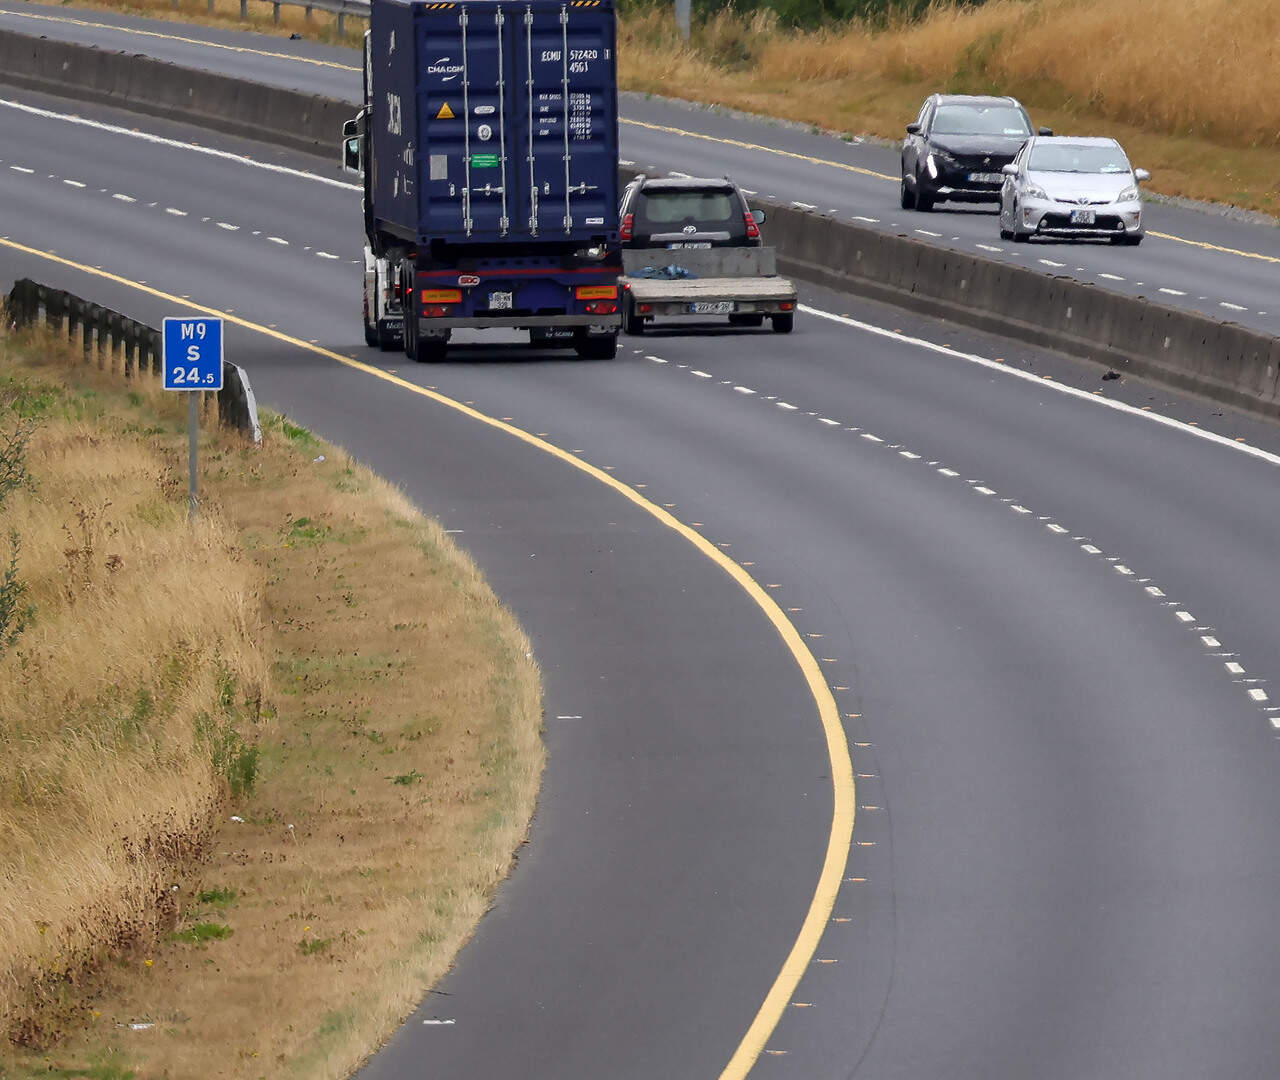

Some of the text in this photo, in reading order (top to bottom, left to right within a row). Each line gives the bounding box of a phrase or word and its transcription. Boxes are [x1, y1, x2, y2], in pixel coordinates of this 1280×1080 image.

[181, 322, 207, 340] M9
[186, 345, 201, 361] S
[173, 366, 215, 384] 24.5
